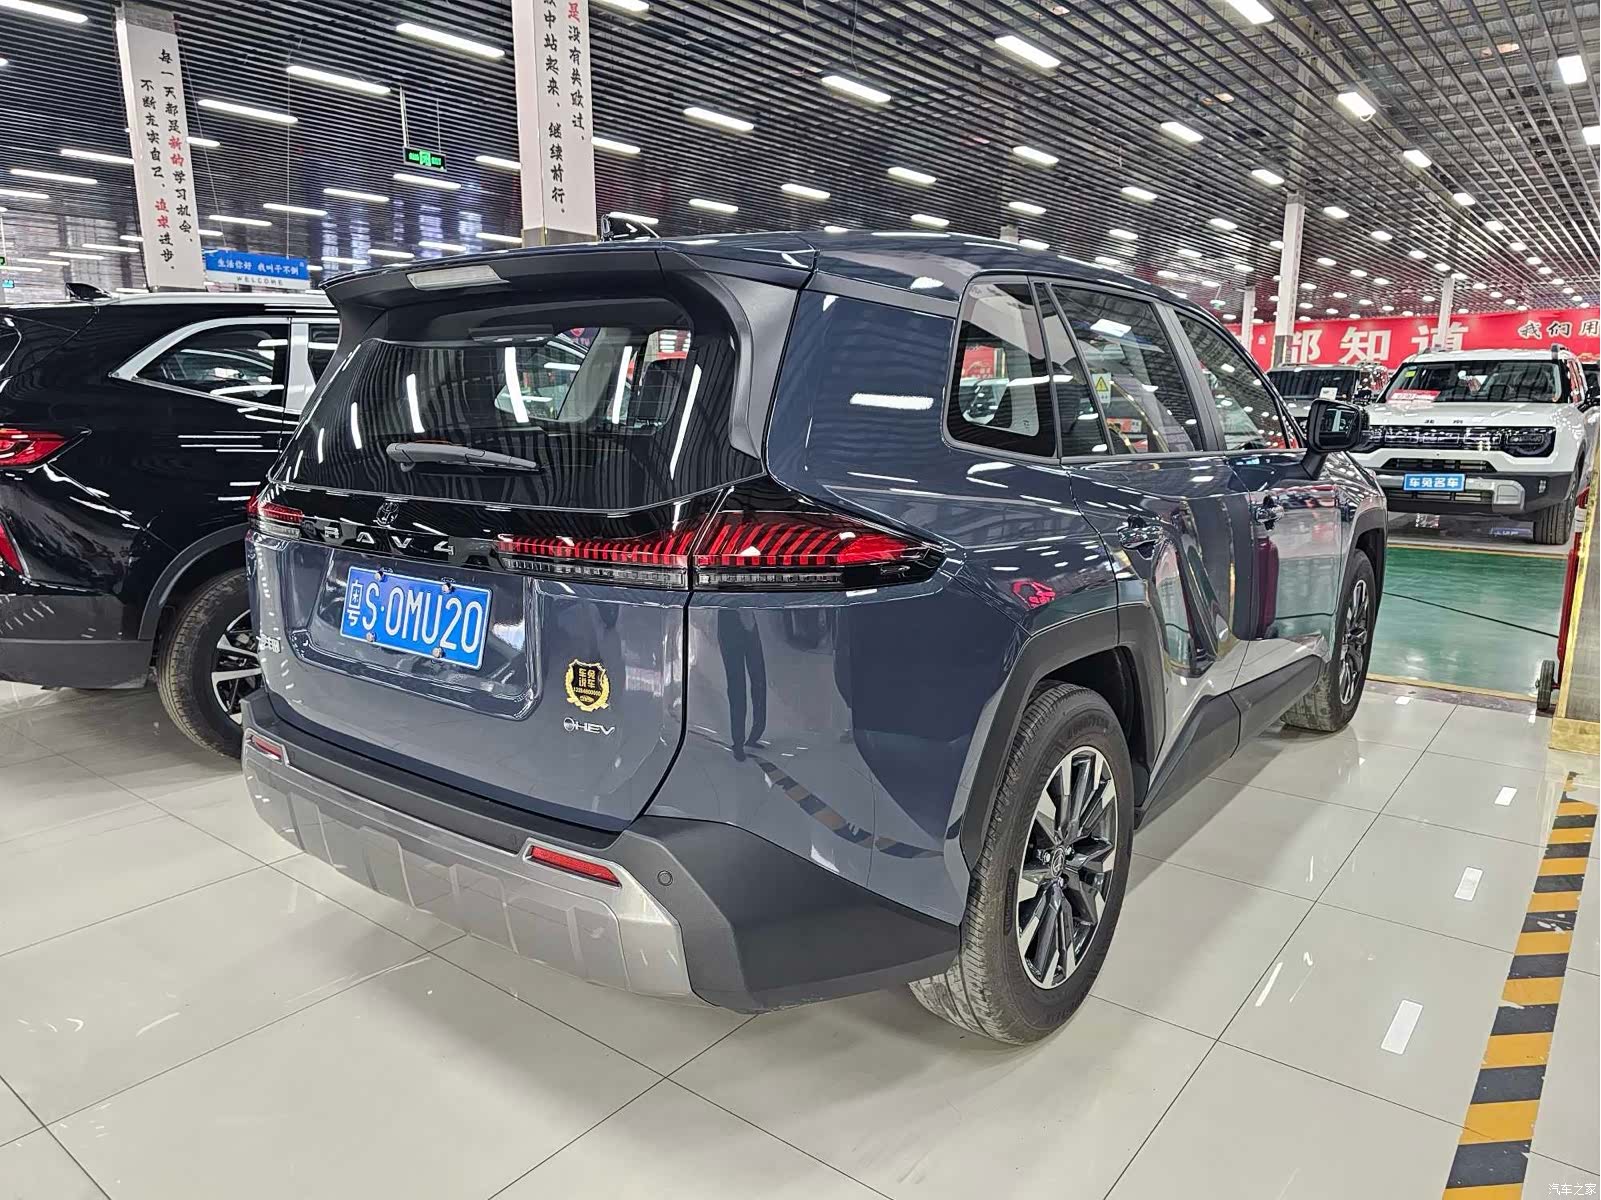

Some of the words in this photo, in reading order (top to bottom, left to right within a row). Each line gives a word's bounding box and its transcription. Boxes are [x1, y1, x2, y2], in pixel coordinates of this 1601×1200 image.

[217, 258, 252, 270] 生活你好
[236, 275, 284, 286] WELCOME
[575, 721, 615, 736] HEV
